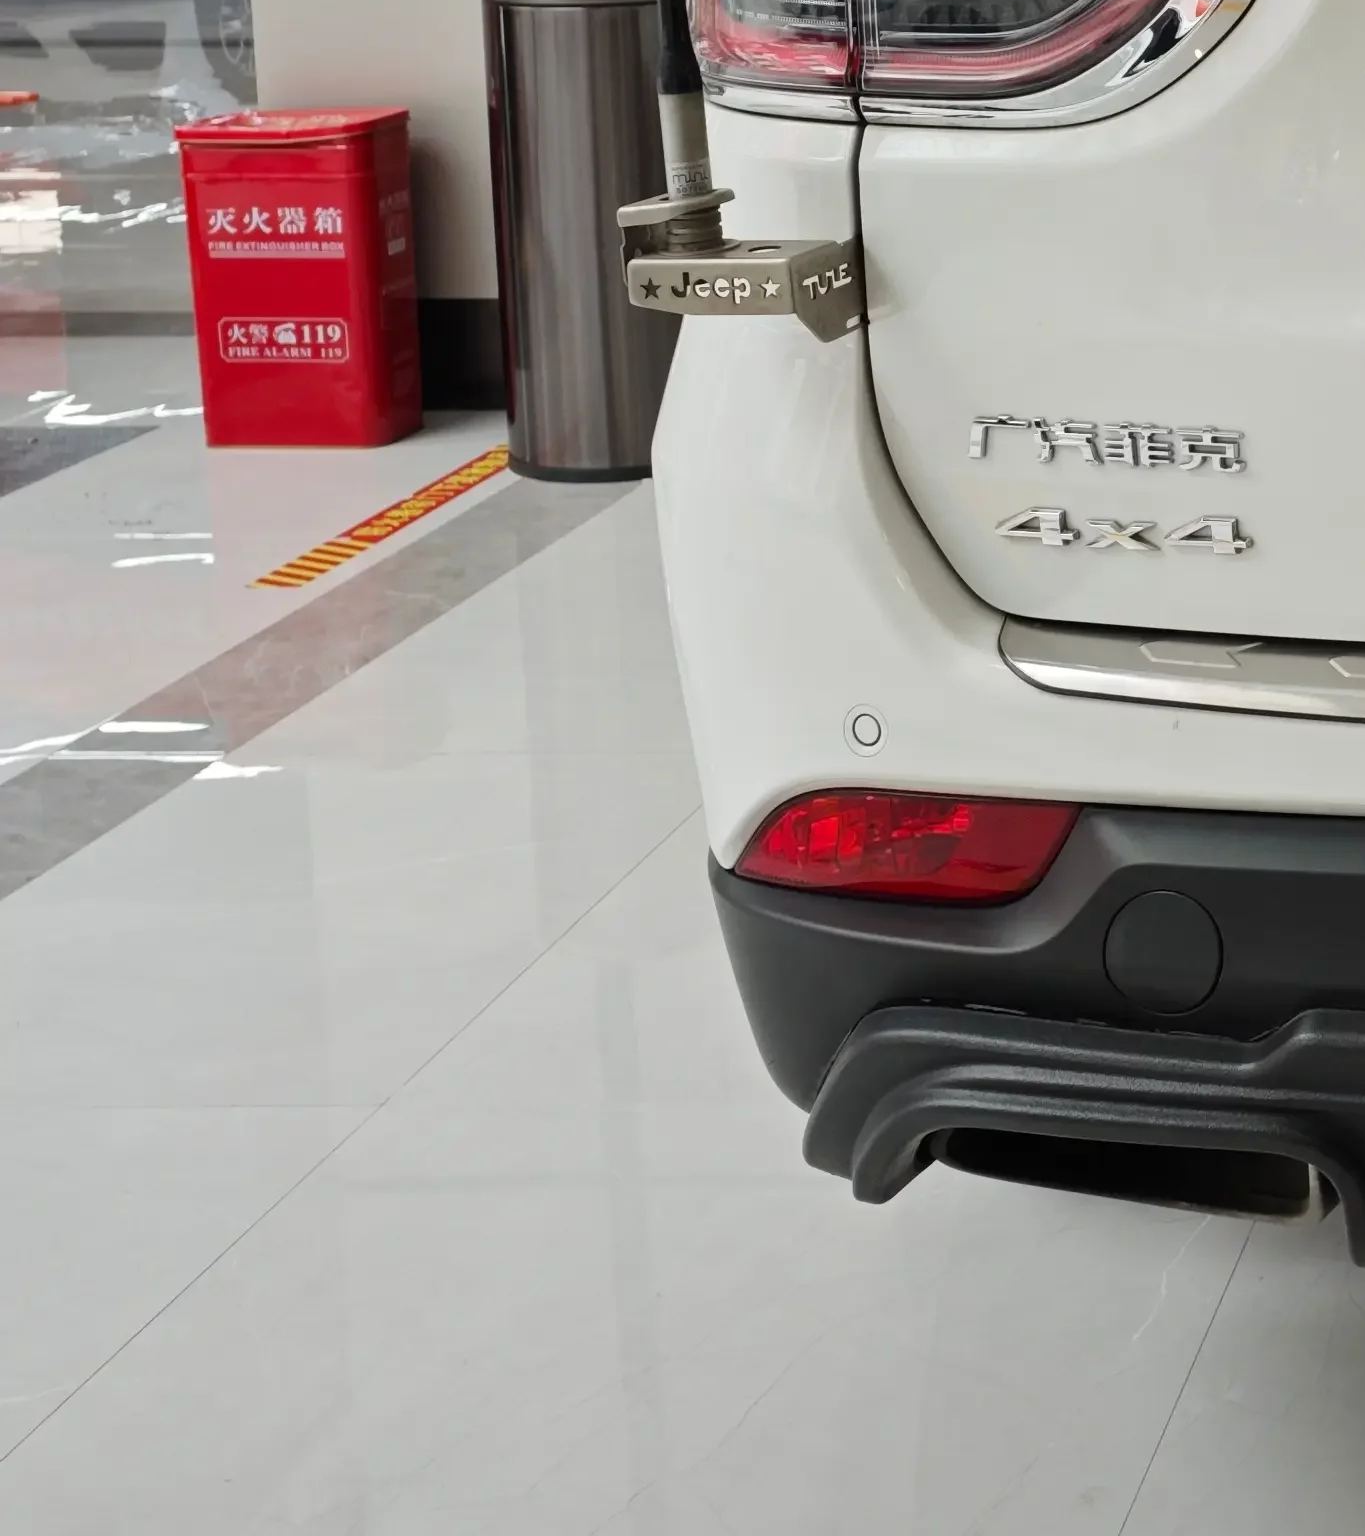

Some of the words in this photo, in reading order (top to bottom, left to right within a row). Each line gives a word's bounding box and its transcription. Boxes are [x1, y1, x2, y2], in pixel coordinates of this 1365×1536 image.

[206, 207, 344, 235] 灭火器箱
[671, 271, 751, 305] Jeep
[227, 323, 269, 345] 火警
[301, 323, 342, 345] 119
[228, 346, 259, 358] FIRE
[263, 346, 313, 358] ALARM
[320, 346, 343, 358] 119
[968, 414, 1247, 472] 广汽菲克
